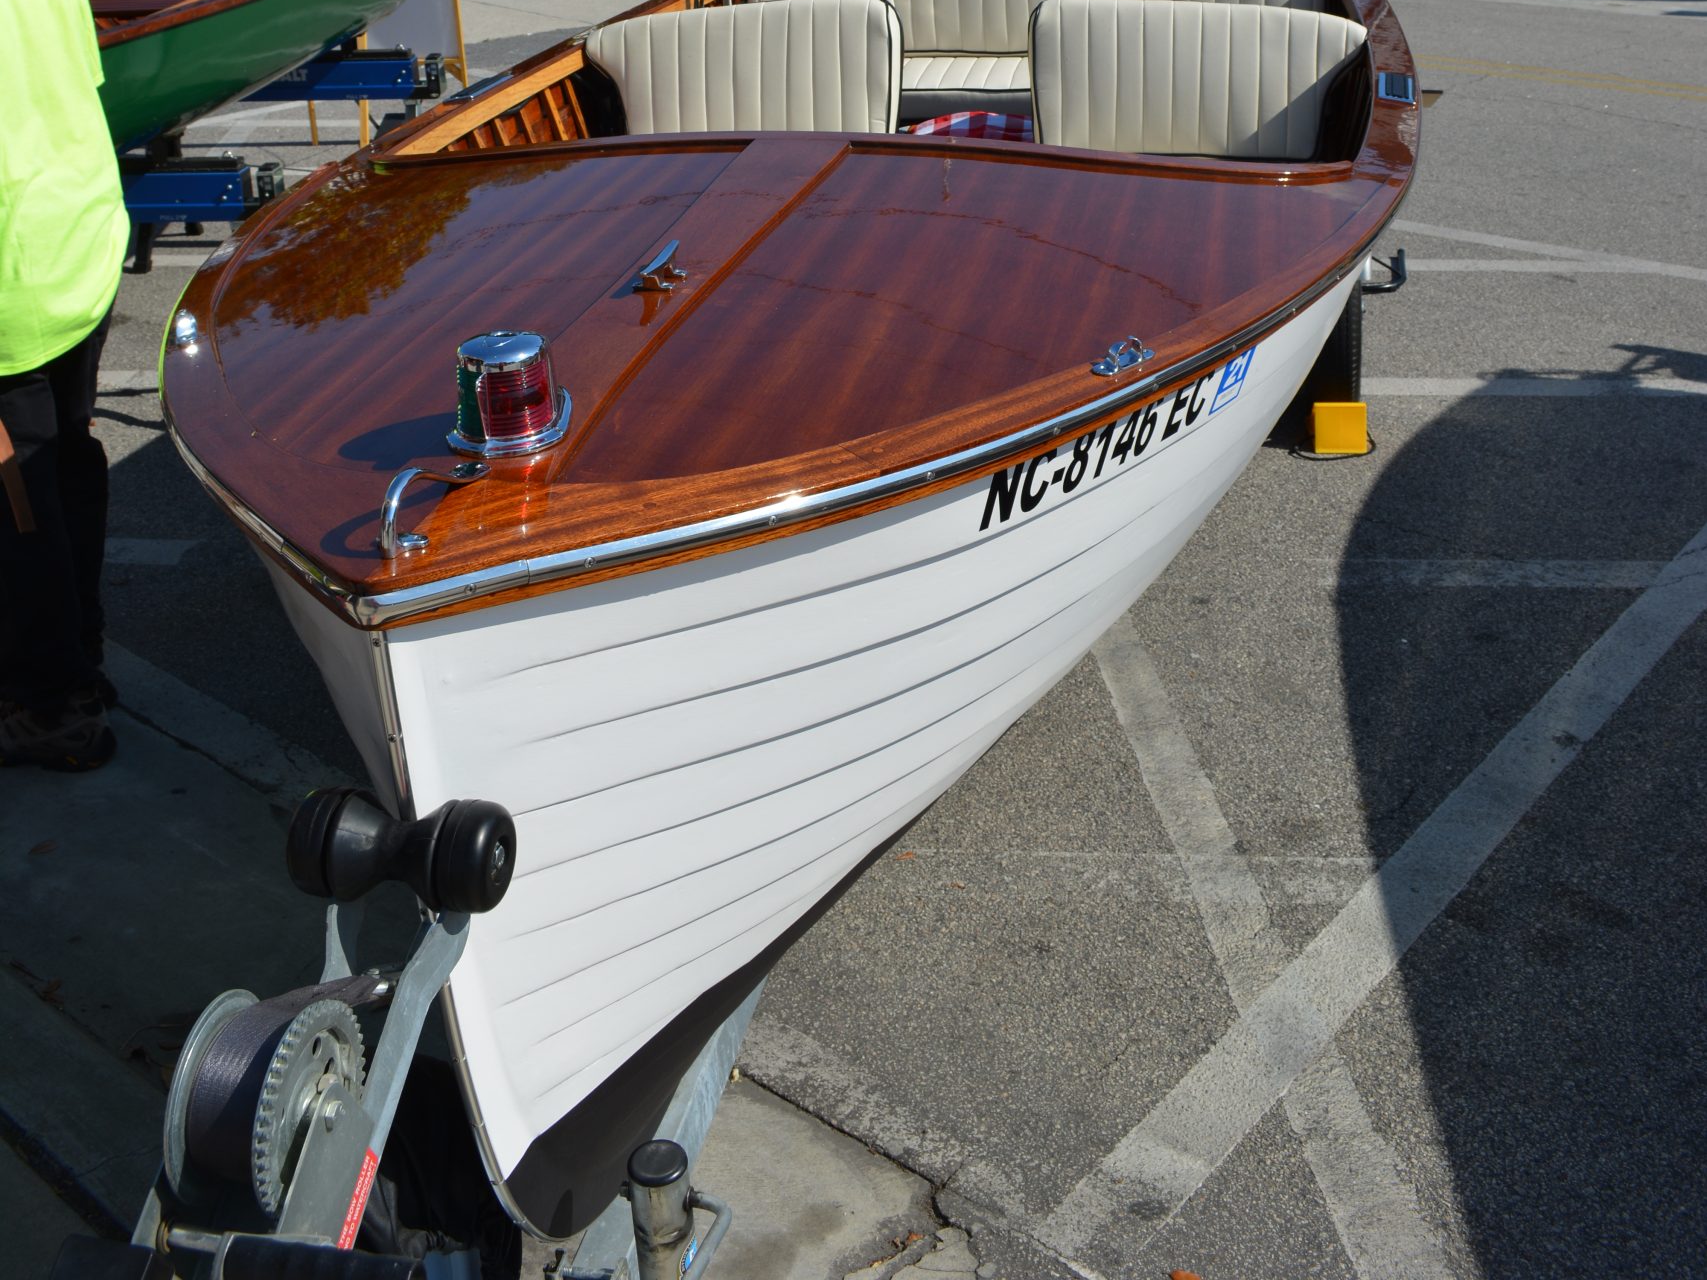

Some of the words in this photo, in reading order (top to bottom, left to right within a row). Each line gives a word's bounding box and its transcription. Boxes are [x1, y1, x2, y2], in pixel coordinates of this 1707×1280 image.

[281, 69, 308, 81] ALT
[979, 398, 1164, 532] NC-8146
[1161, 369, 1216, 442] EC
[340, 1226, 349, 1244] THE
[347, 1197, 357, 1222] BOW
[355, 1155, 371, 1195] ROLLER
[348, 1222, 355, 1235] TO
[353, 1160, 375, 1220] WATERCRAFT
